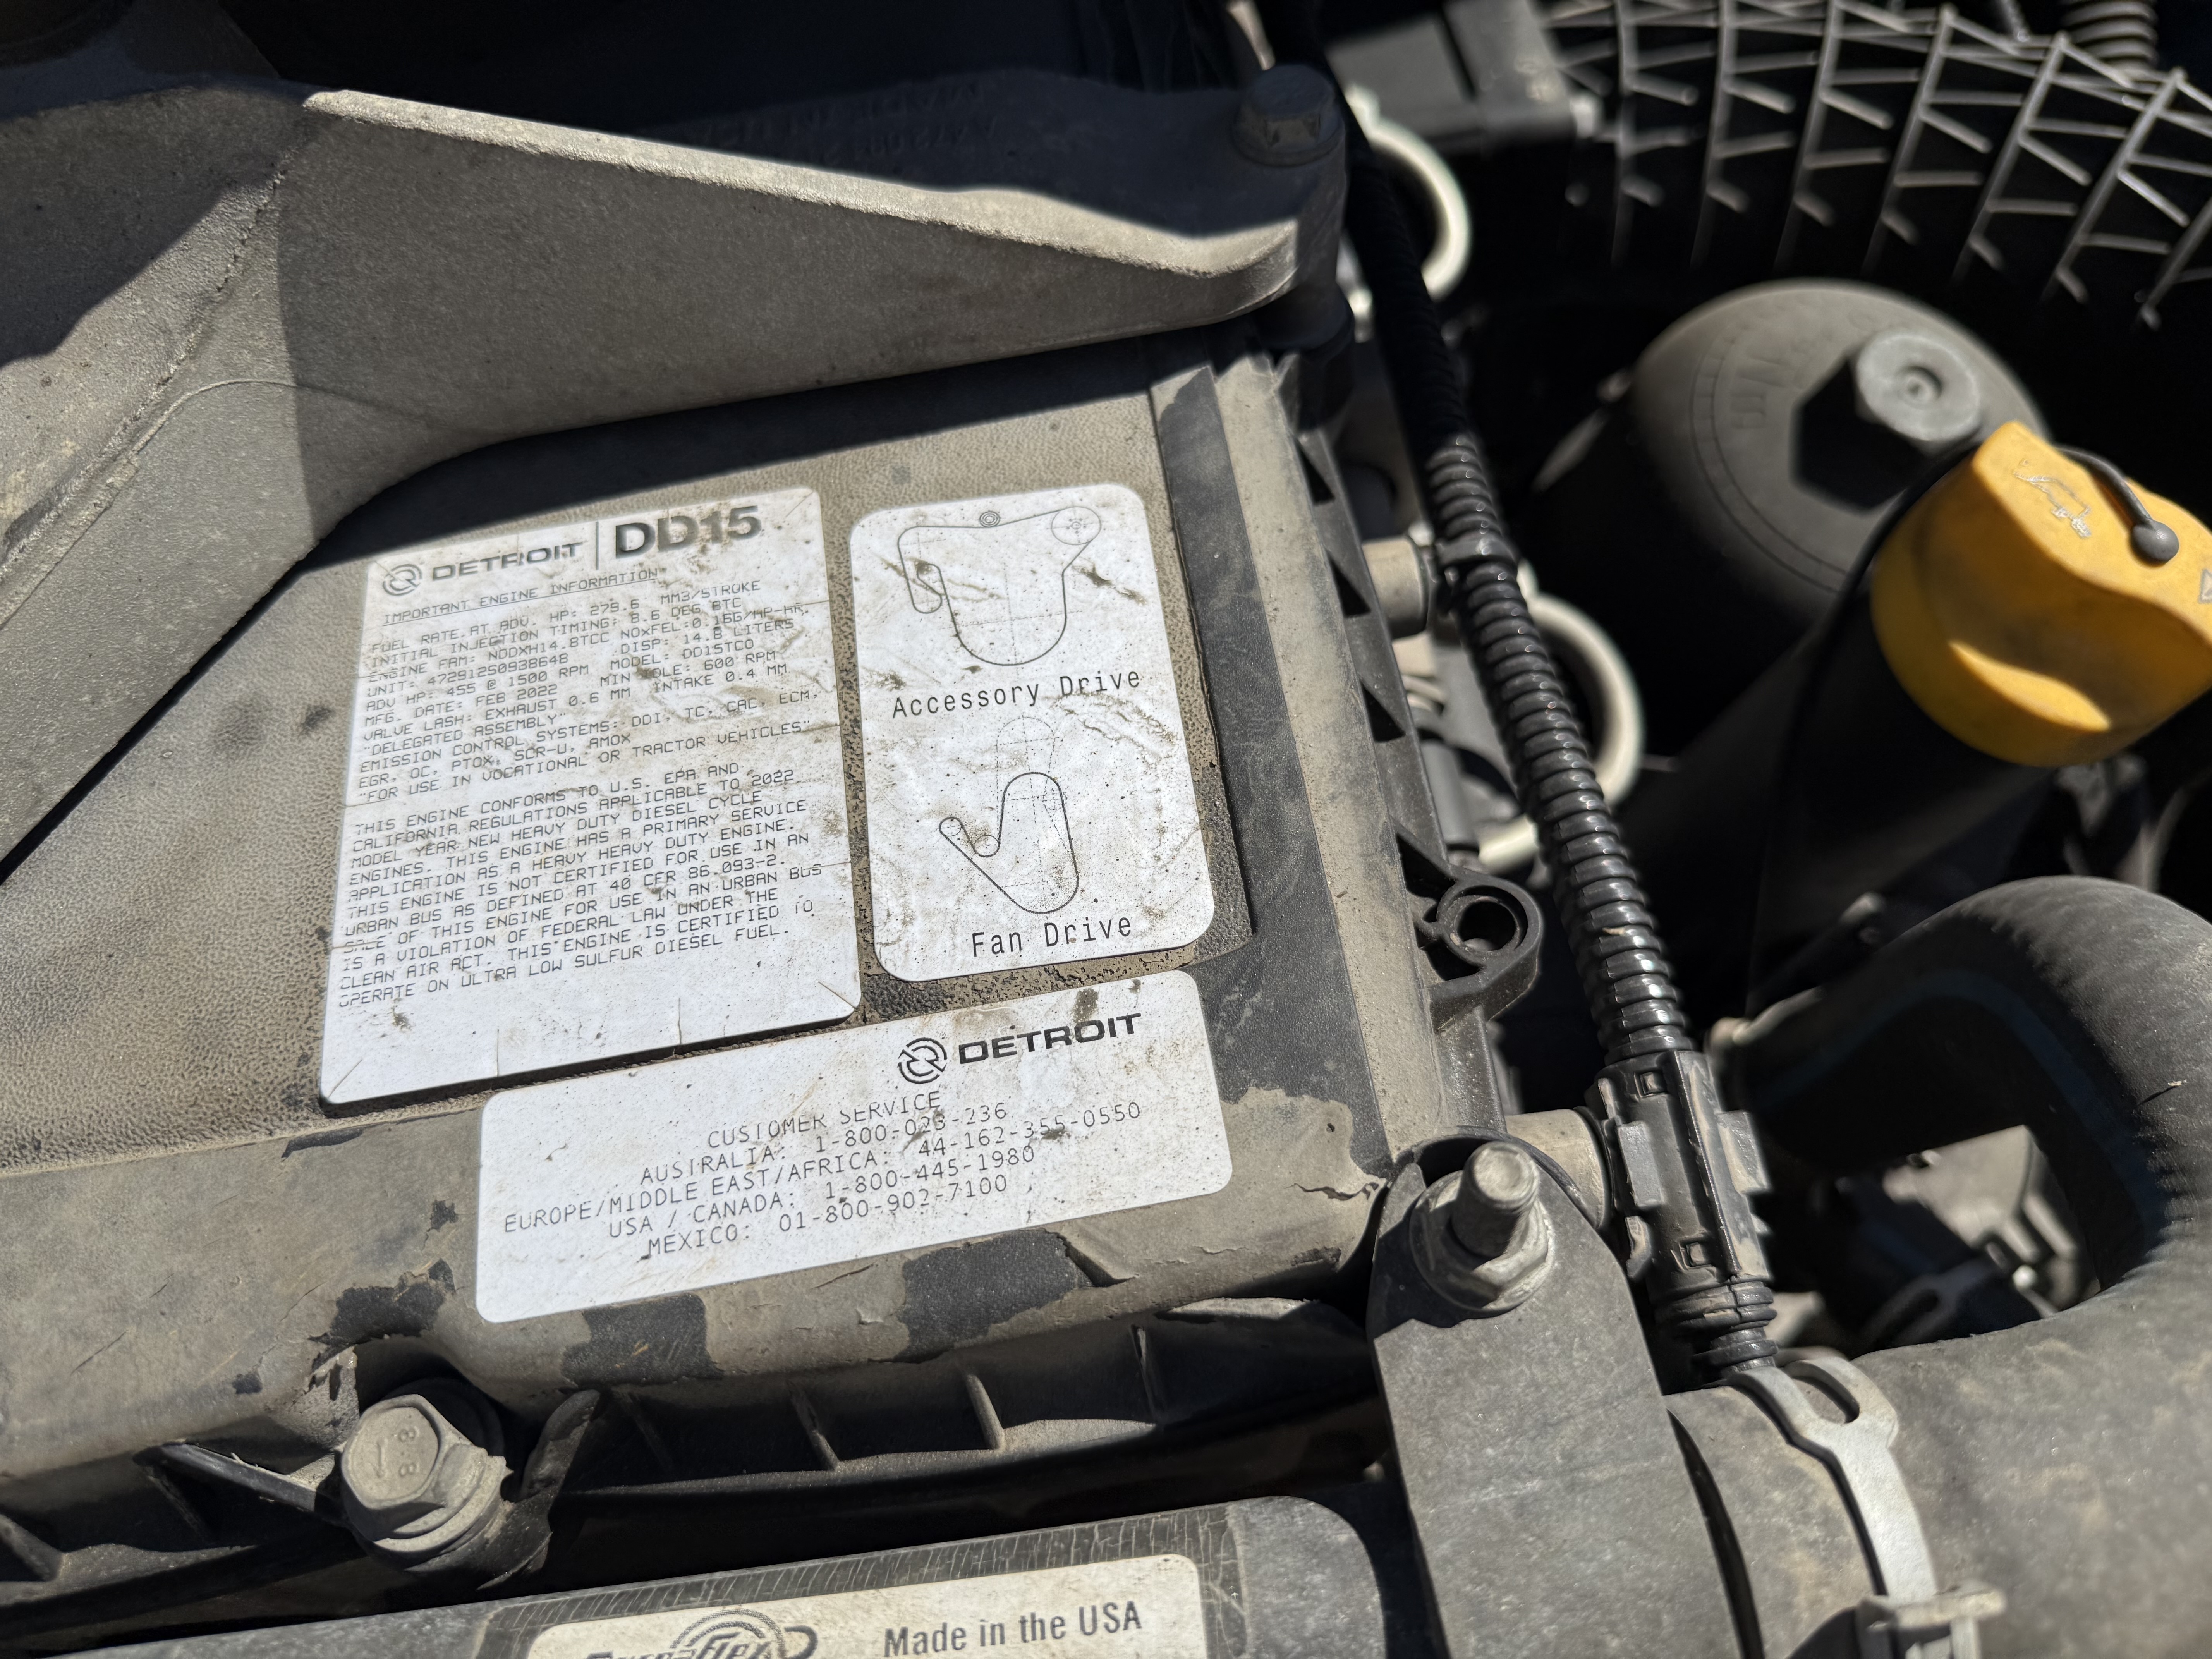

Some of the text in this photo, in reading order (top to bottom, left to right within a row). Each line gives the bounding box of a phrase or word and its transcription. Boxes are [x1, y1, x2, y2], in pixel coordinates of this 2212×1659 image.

[433, 505, 762, 580] DETROIT DD15
[371, 599, 639, 653] FUEL AT HP: 279.6
[371, 596, 742, 667] INITIAL INJECTION TIMING: 8.6 DEG BTC
[385, 568, 658, 624] IMPORTANT ENGINE INFORMATION
[438, 654, 477, 670] FAM:
[620, 618, 794, 654] DISP: 14.8 LITERS
[362, 663, 787, 742] VALVE LASH: EXHAUST 0.6 MM INTAKE 0.4 MM
[366, 651, 669, 711] ADV HP: 455 1500 RPM MODEL:
[415, 649, 776, 718] DATE: FEB 2022 MIN 600 RPM
[892, 670, 1140, 719] Accessory Drive
[359, 719, 618, 772] EMISSION CONTROL SYSTEMS:
[409, 736, 705, 794] USE IN VOCATIONAL OR TRACTOR
[589, 732, 630, 749] AMOX
[351, 790, 763, 869] MODEL NEW HEAVY DUTY DIESEL CYCLE
[352, 769, 795, 852] CALIFORNIA REGULATIONS APPLICABLE TO 2022
[354, 762, 739, 836] THIS ENGINE CONFORMS TO U.S. EPA AND
[347, 817, 794, 902] APPLICATION AS A HEAVY HEAVY DUTY ENGINE.
[347, 832, 809, 919] THIS ENGINE IS NOT CERTIFIED FOR USE IN AN
[349, 799, 808, 885] ENGINES. THIS ENGINE HAS A PRIMARY SERVICE
[345, 852, 787, 936] URBAN BUS AS DEFINED AT 40 CFR 86.093-2.
[374, 887, 779, 966] A VIOLATION OF FEDERAL LAW UNDER THE
[398, 870, 777, 945] OF THIS ENGINE FOR USE IN AN URBAN
[340, 905, 780, 990] CLEAN AIR ACT. THIS ENGINE IS CERTIFIED
[428, 921, 789, 993] ON ULTRA LOW SULFUR DIESEL FUEL.
[972, 916, 1131, 957] Fan Drive
[958, 1012, 1141, 1064] DETROIT
[641, 1102, 1007, 1185] AUSTRALIA: 1-800-023-236
[708, 1090, 941, 1149] CUSTOMER SERVICE
[505, 1101, 1141, 1234] EUROPE/MIDDLE EAST/AFRICA: 44-162-355-0550
[609, 1145, 1036, 1239] USA / CANADA: 1-800-445-1980
[648, 1175, 1007, 1255] MEXICO: 01-800-902-7100
[884, 1600, 1142, 1657] Made in the USA
